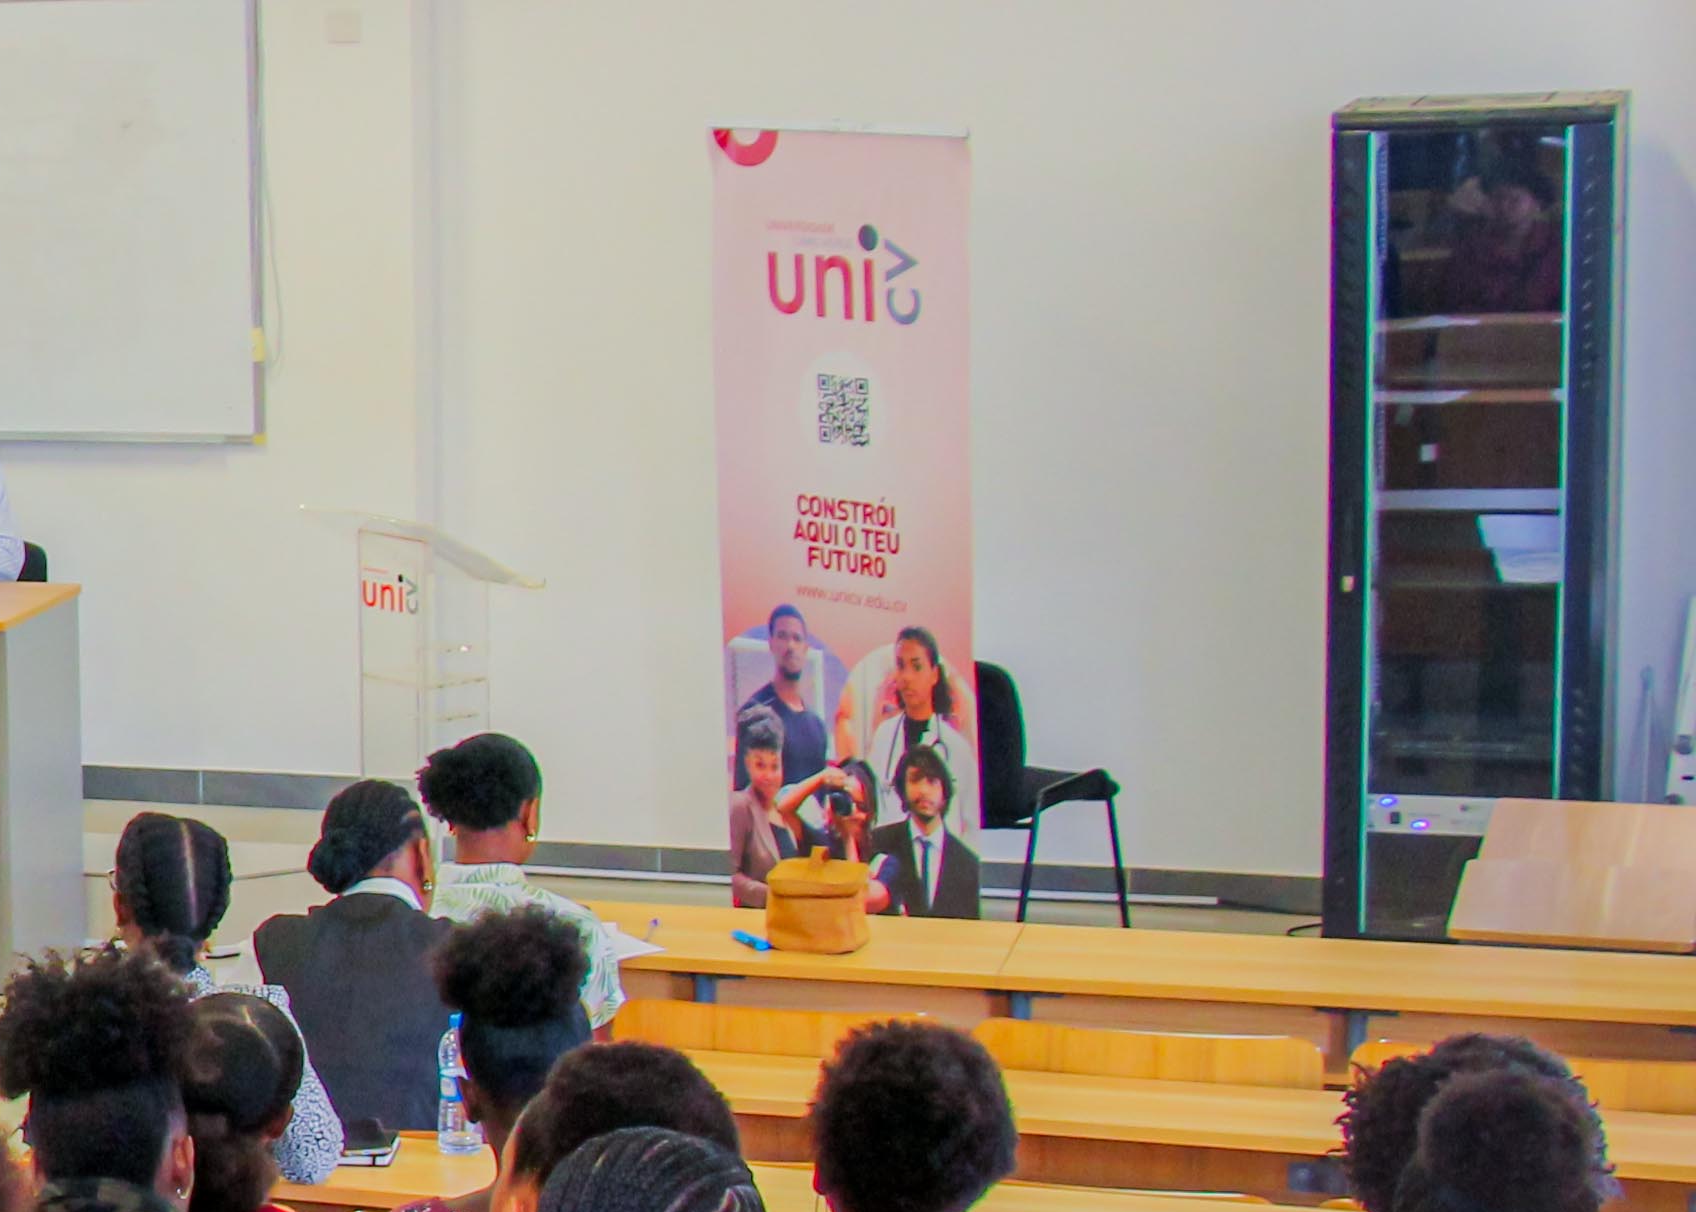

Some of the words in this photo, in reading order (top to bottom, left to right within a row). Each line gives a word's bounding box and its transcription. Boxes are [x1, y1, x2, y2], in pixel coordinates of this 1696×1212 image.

[796, 494, 896, 529] CONSTRÓI
[793, 519, 839, 546] AQUI
[844, 526, 857, 548] O
[861, 528, 901, 555] TEU
[807, 546, 887, 578] FUTURO
